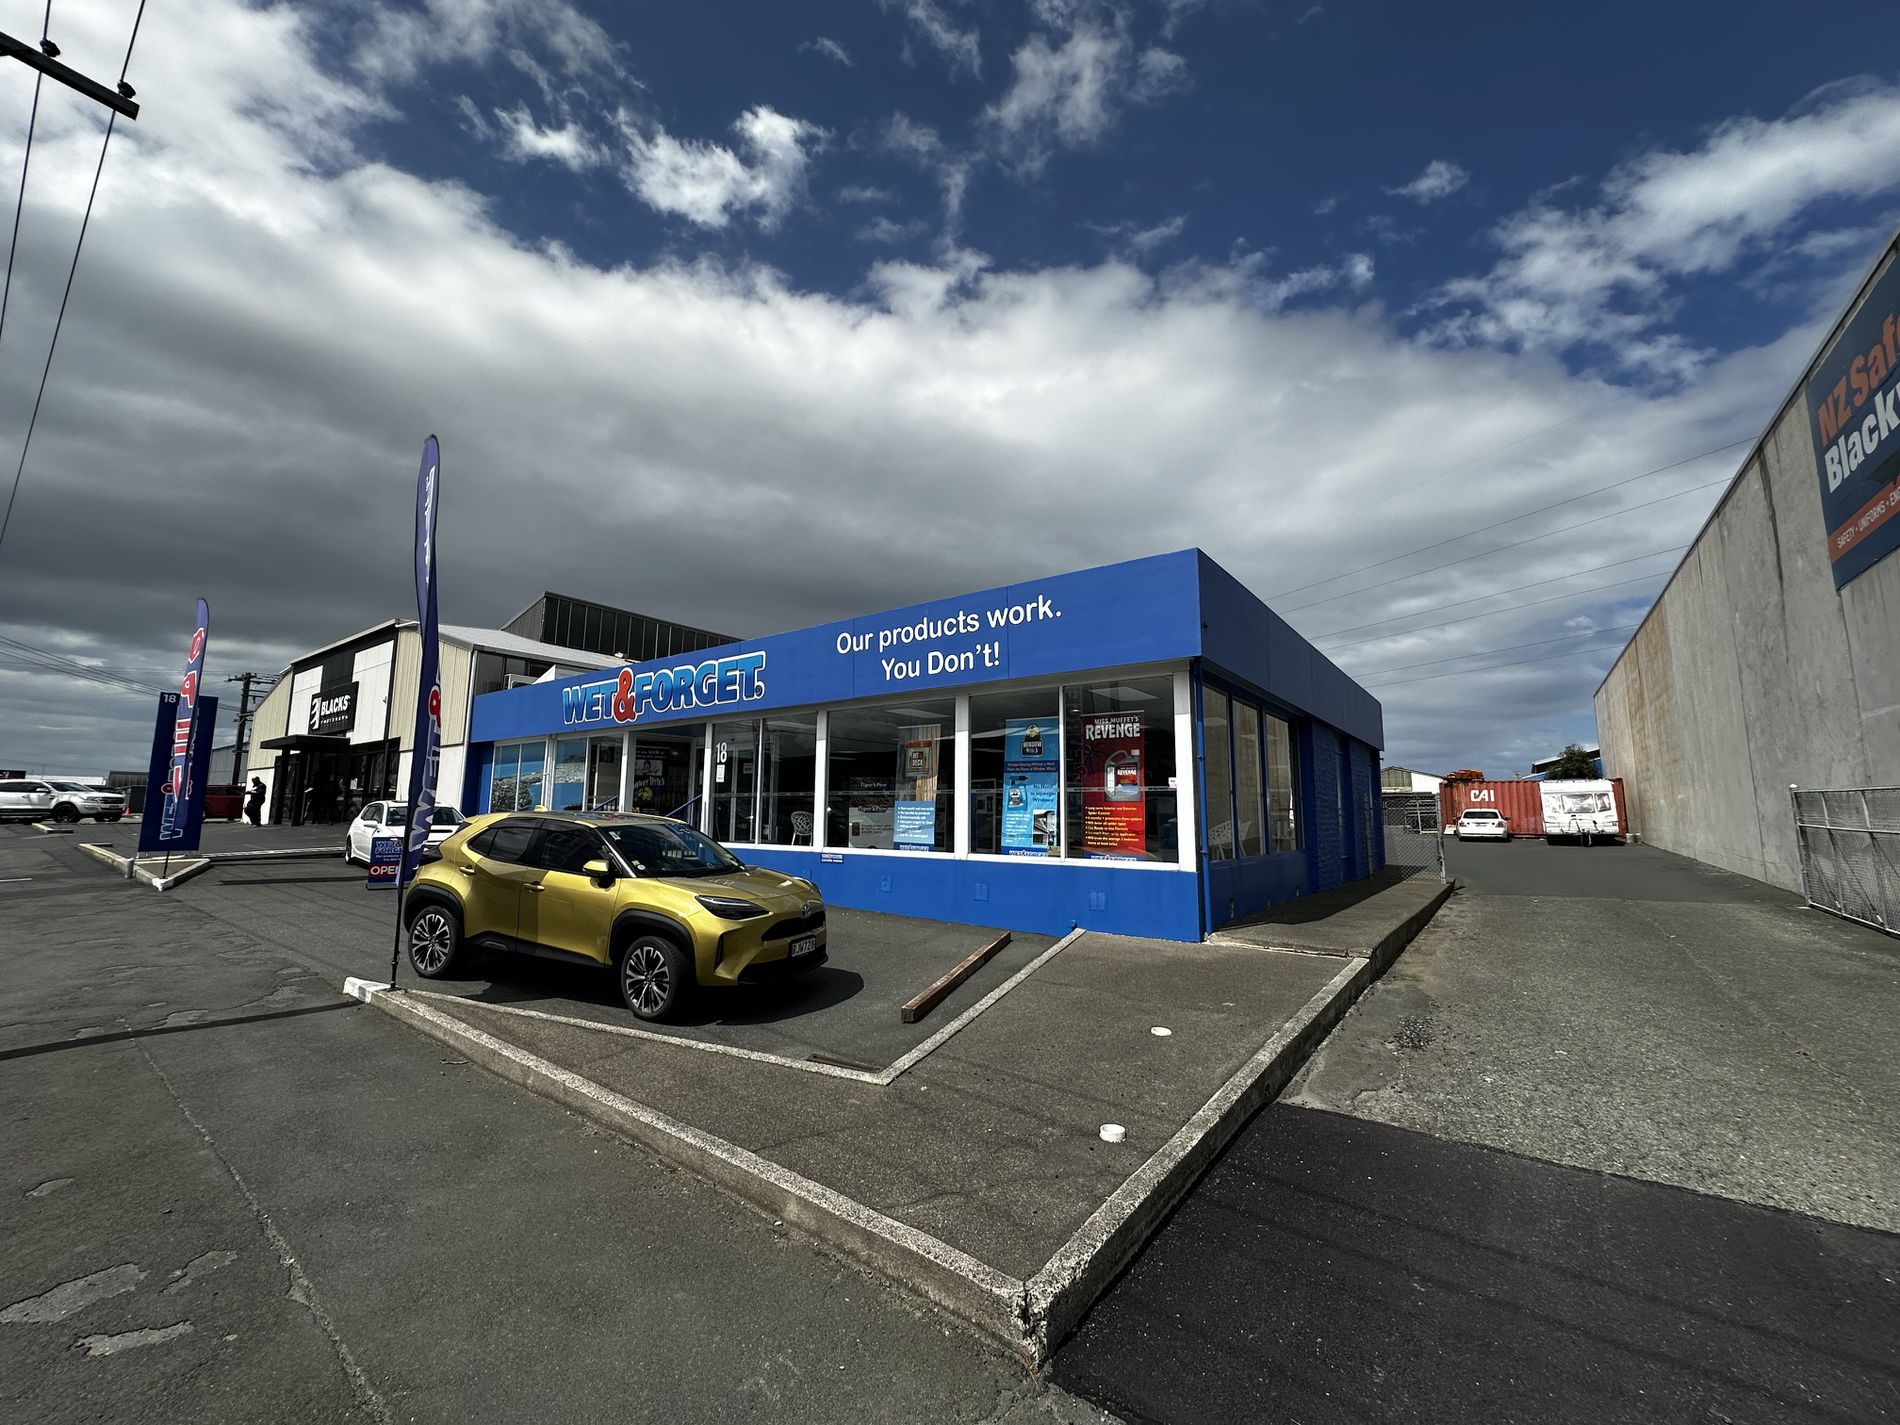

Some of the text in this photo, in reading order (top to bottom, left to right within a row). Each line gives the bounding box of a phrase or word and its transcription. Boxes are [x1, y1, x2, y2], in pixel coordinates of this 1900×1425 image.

[1818, 375, 1850, 447] NZ
[1824, 380, 1900, 493] Black
[1837, 523, 1856, 550] SAFETY
[1857, 500, 1885, 535] UNIFORMS
[836, 594, 1062, 654] Our products work.
[881, 641, 1000, 681] You Don't!
[163, 694, 177, 704] 18
[320, 694, 351, 716] BLACKS
[1110, 714, 1139, 723] MUFFET'S
[1085, 722, 1141, 741] REVENGE
[716, 742, 728, 763] 18
[1470, 789, 1495, 802] CAI
